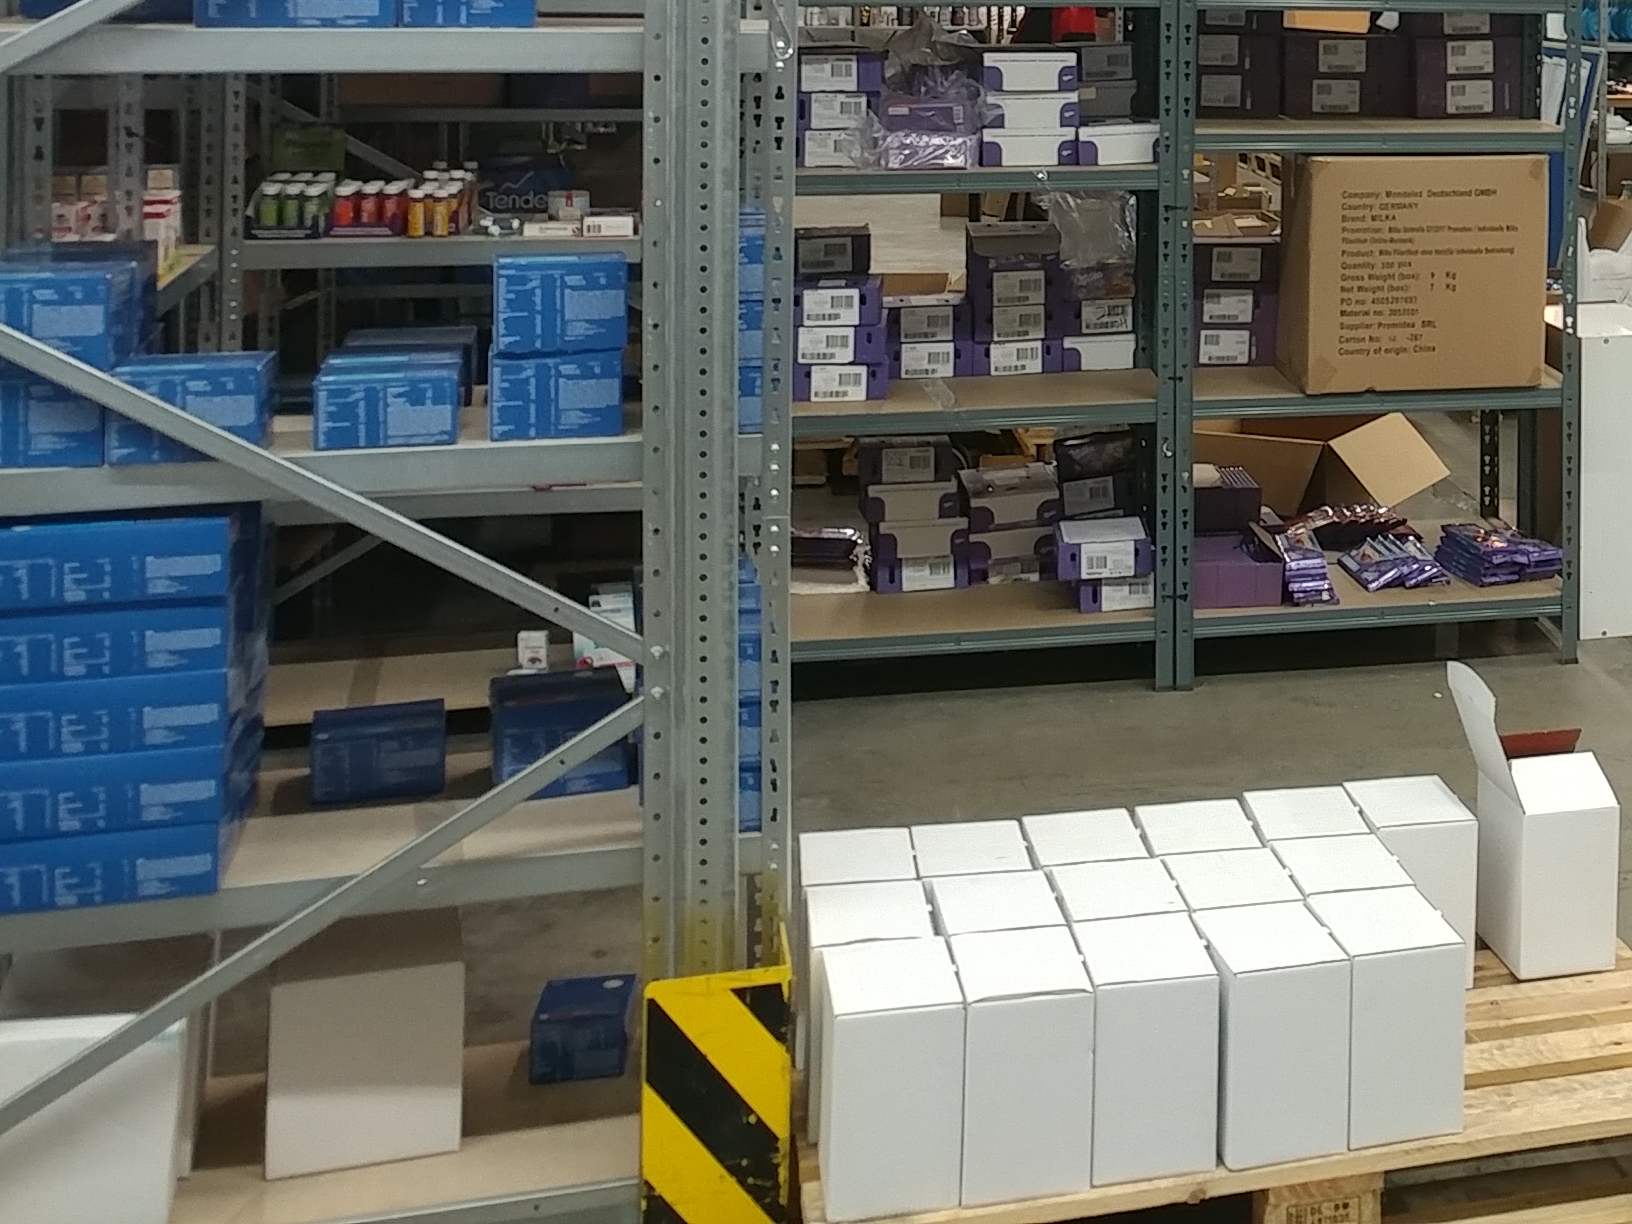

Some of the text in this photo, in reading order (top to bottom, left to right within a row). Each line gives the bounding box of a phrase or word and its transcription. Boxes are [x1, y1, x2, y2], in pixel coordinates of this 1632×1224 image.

[1341, 190, 1381, 200] Company:
[1341, 202, 1419, 213] Country: GERMANY
[1370, 214, 1396, 222] MILKA
[1367, 272, 1396, 283] Weight
[1357, 284, 1385, 294] Weight
[1338, 347, 1371, 356] Country
[1373, 346, 1382, 355] of
[1413, 344, 1436, 354] China
